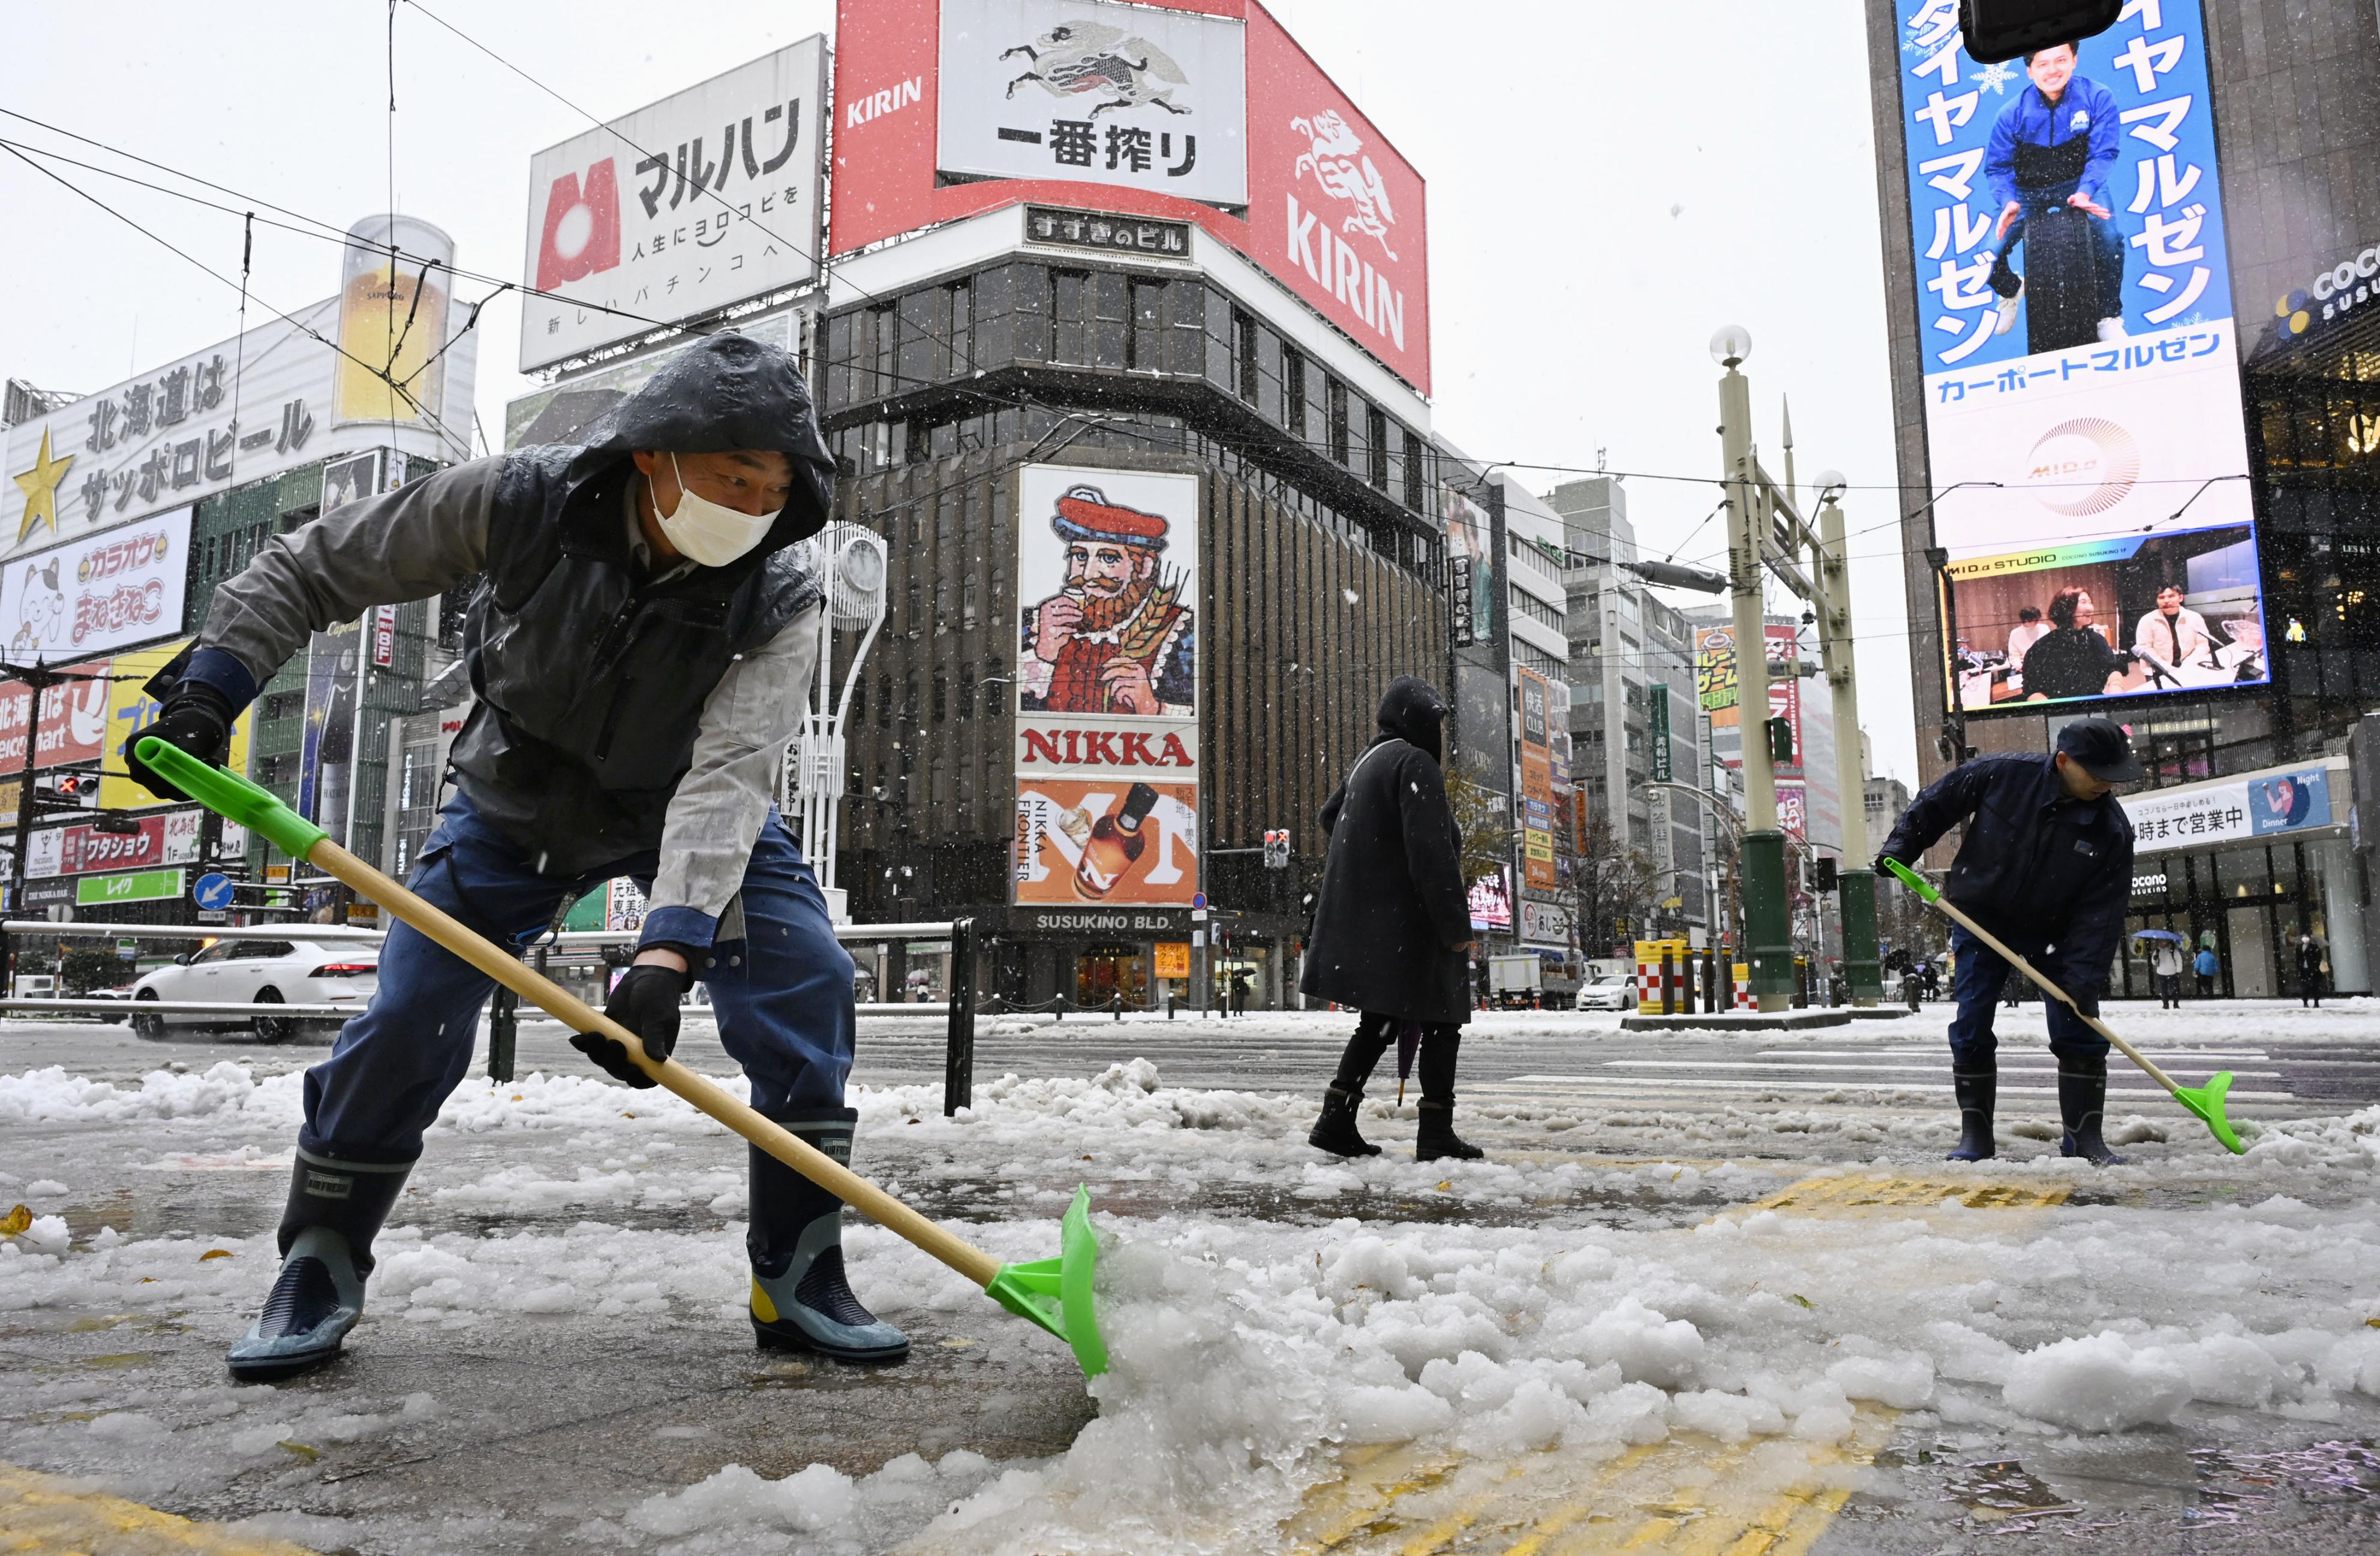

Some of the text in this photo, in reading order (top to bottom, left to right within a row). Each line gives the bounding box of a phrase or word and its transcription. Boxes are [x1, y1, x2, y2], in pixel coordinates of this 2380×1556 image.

[847, 76, 922, 129] KIRIN
[635, 98, 800, 220] マルハン
[997, 118, 1196, 177] 一番搾り
[632, 186, 798, 263] 人生にヨロコビを
[1034, 216, 1182, 252] すすきのビル
[1287, 192, 1405, 353] KIRIN
[1937, 334, 2220, 404] カーポートマルゼン
[87, 355, 225, 453] 北海道は
[82, 399, 313, 522] サッポロビール
[91, 532, 155, 579] カラオケ
[1994, 554, 2057, 569] STUDIO
[2088, 549, 2119, 557] SUSUKINO
[71, 579, 164, 646] まねきねこ
[1525, 688, 1543, 715] 快活
[1526, 715, 1543, 735] CLUB
[1020, 728, 1194, 768] NIKKA
[2297, 773, 2320, 785] Night
[1035, 800, 1047, 854] NIKKA
[1786, 797, 1800, 829] DAM
[2262, 818, 2288, 828] Dinner
[88, 832, 150, 860] ワタショウ
[168, 845, 178, 861] 1F
[1017, 800, 1030, 881] FRONTIER
[38, 890, 56, 899] NIKKA
[57, 889, 68, 898] BAR
[107, 877, 133, 895] レイク
[1037, 915, 1173, 930] SUSUKINO BLD.
